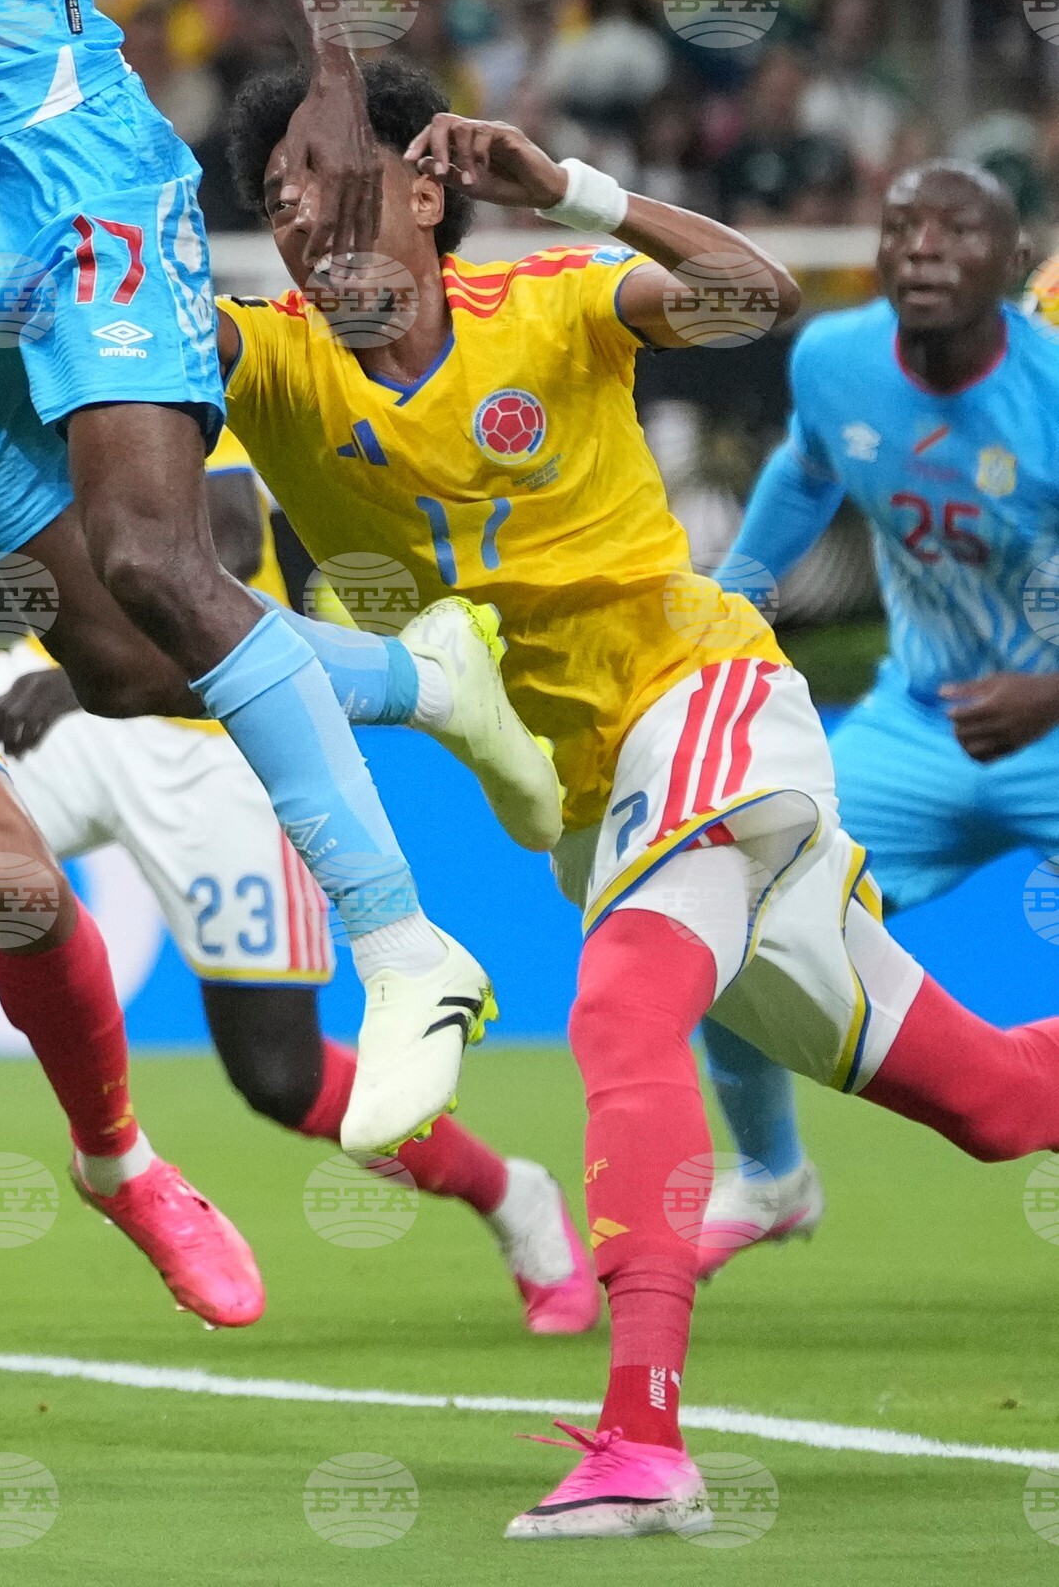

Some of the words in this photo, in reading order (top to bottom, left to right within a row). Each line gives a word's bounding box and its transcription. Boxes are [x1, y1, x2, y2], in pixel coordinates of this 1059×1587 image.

[71, 213, 146, 306] 17
[99, 345, 148, 359] umbro
[891, 491, 992, 567] 25
[189, 875, 276, 956] 23
